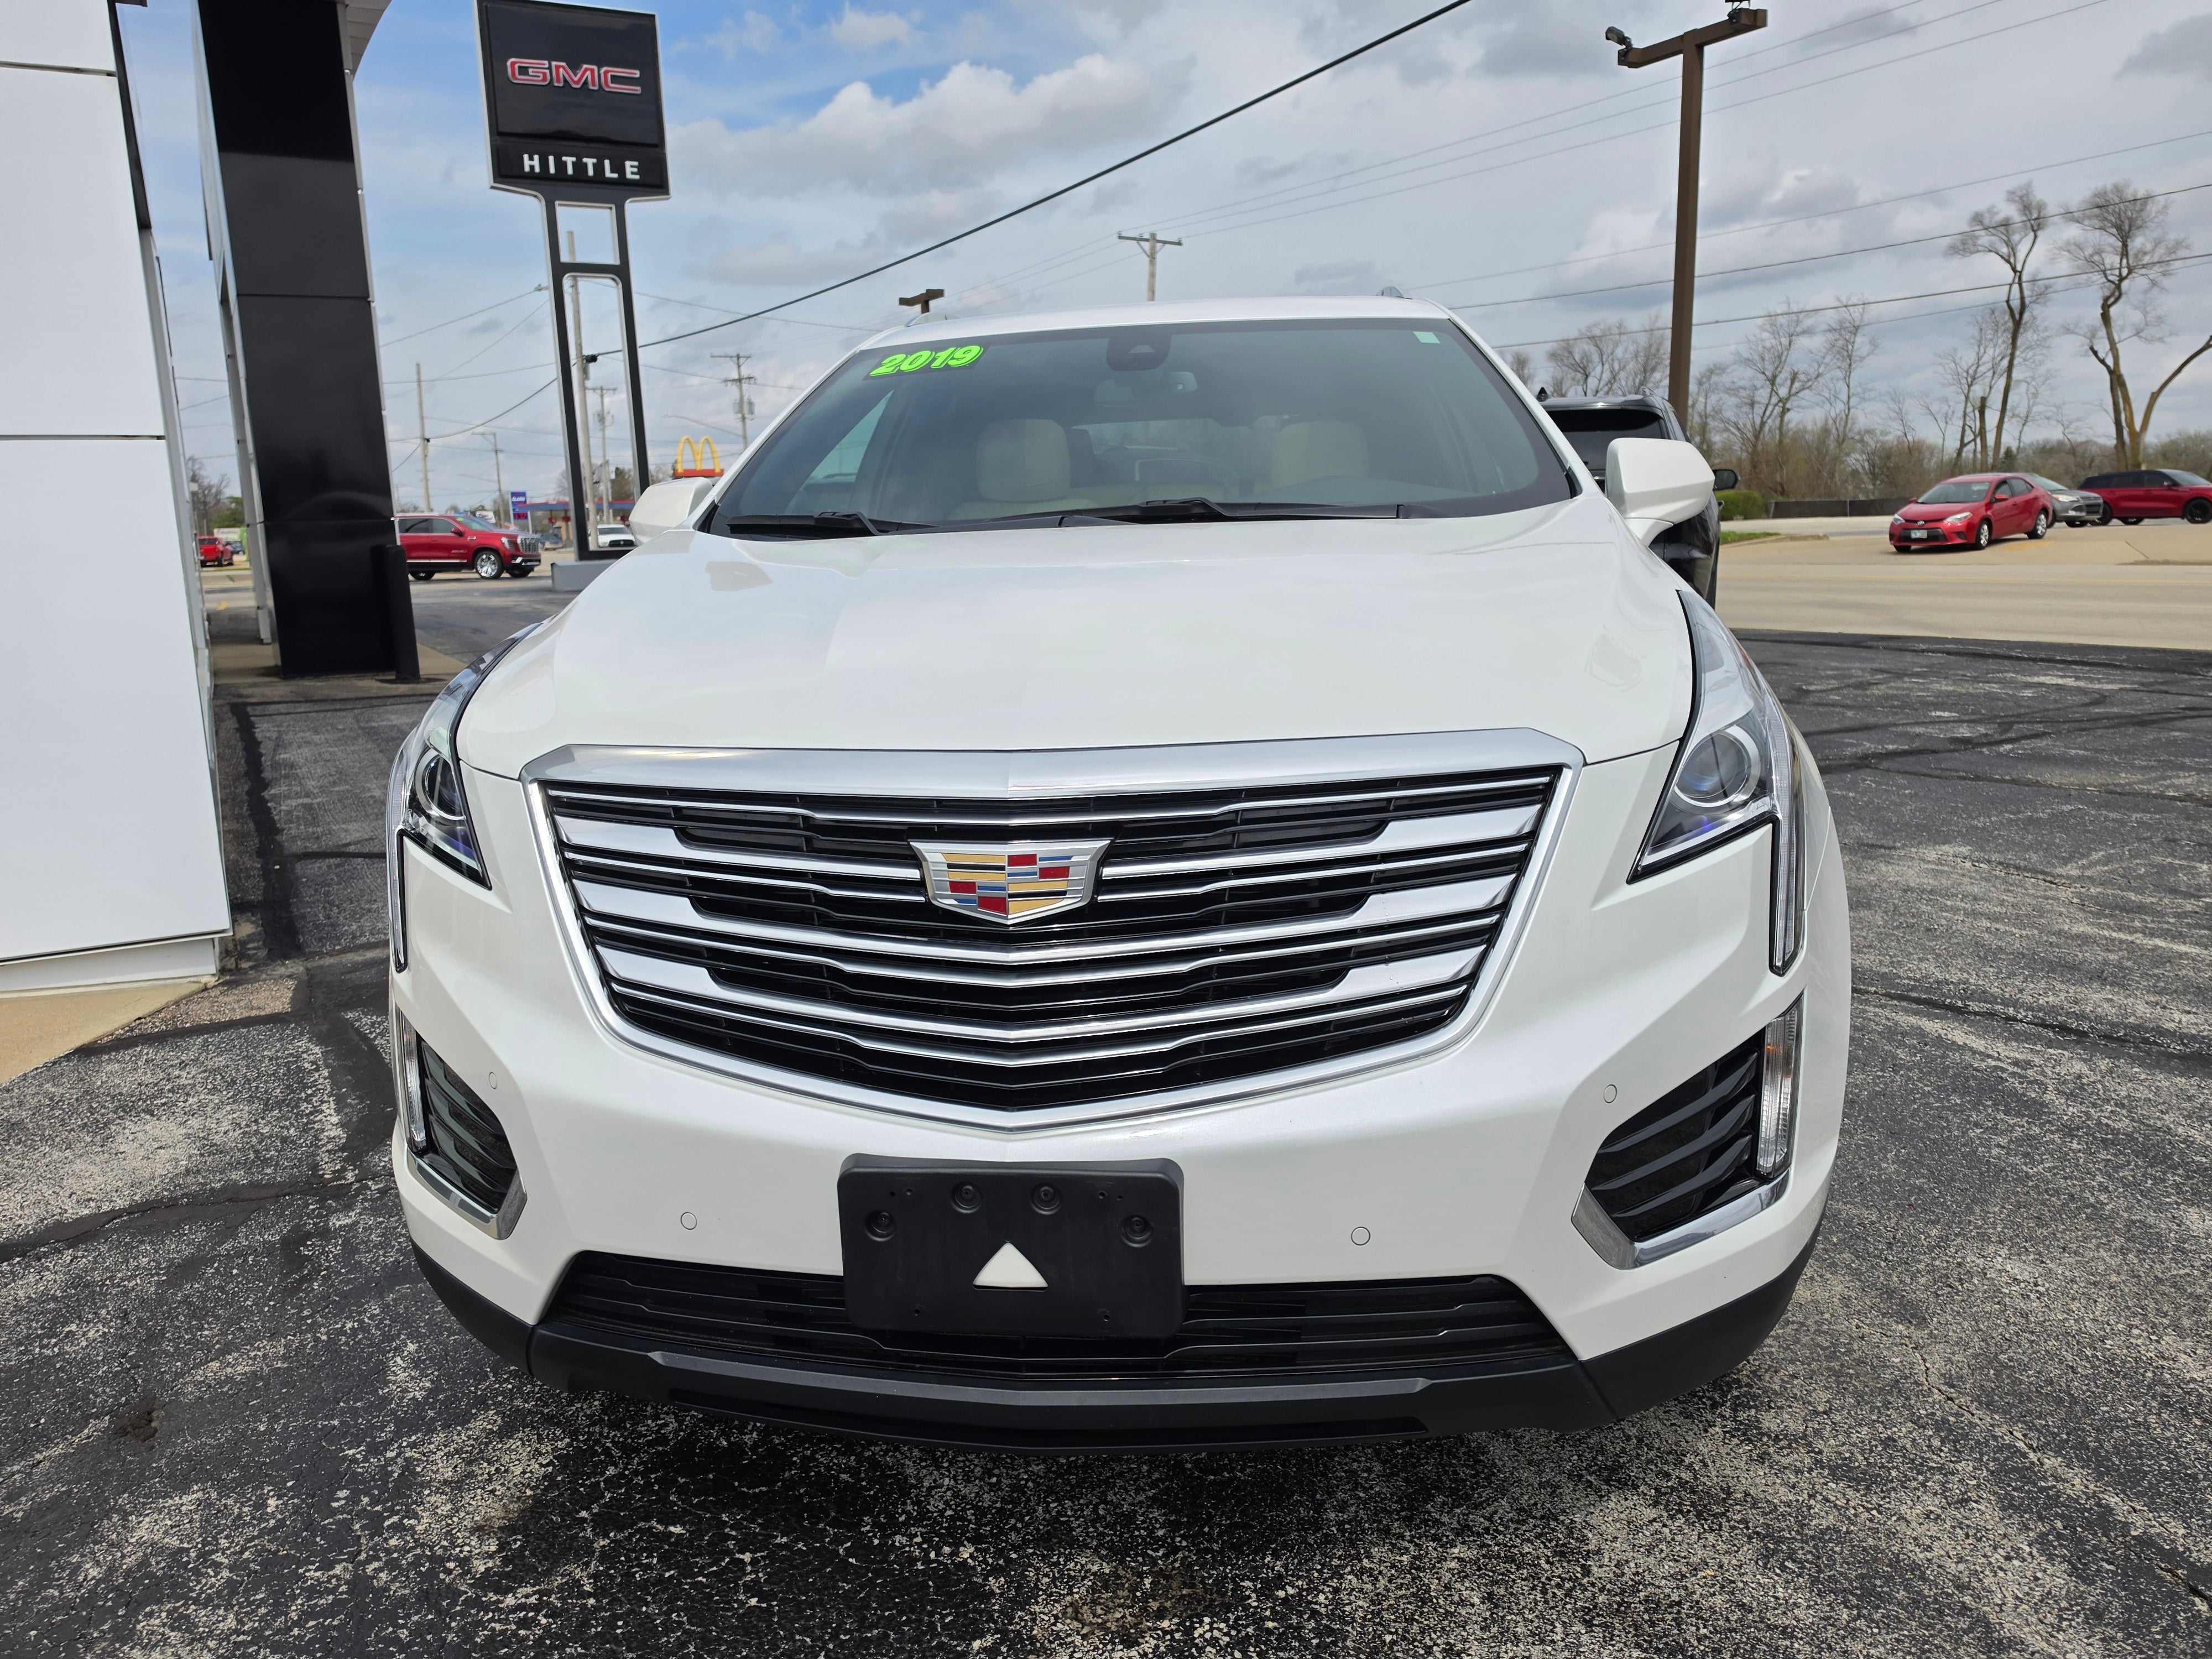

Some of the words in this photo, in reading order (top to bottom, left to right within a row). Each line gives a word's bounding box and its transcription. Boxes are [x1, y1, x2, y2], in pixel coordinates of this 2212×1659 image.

[507, 58, 641, 94] GMC
[523, 153, 640, 179] HITTLE
[869, 346, 984, 377] 2019
